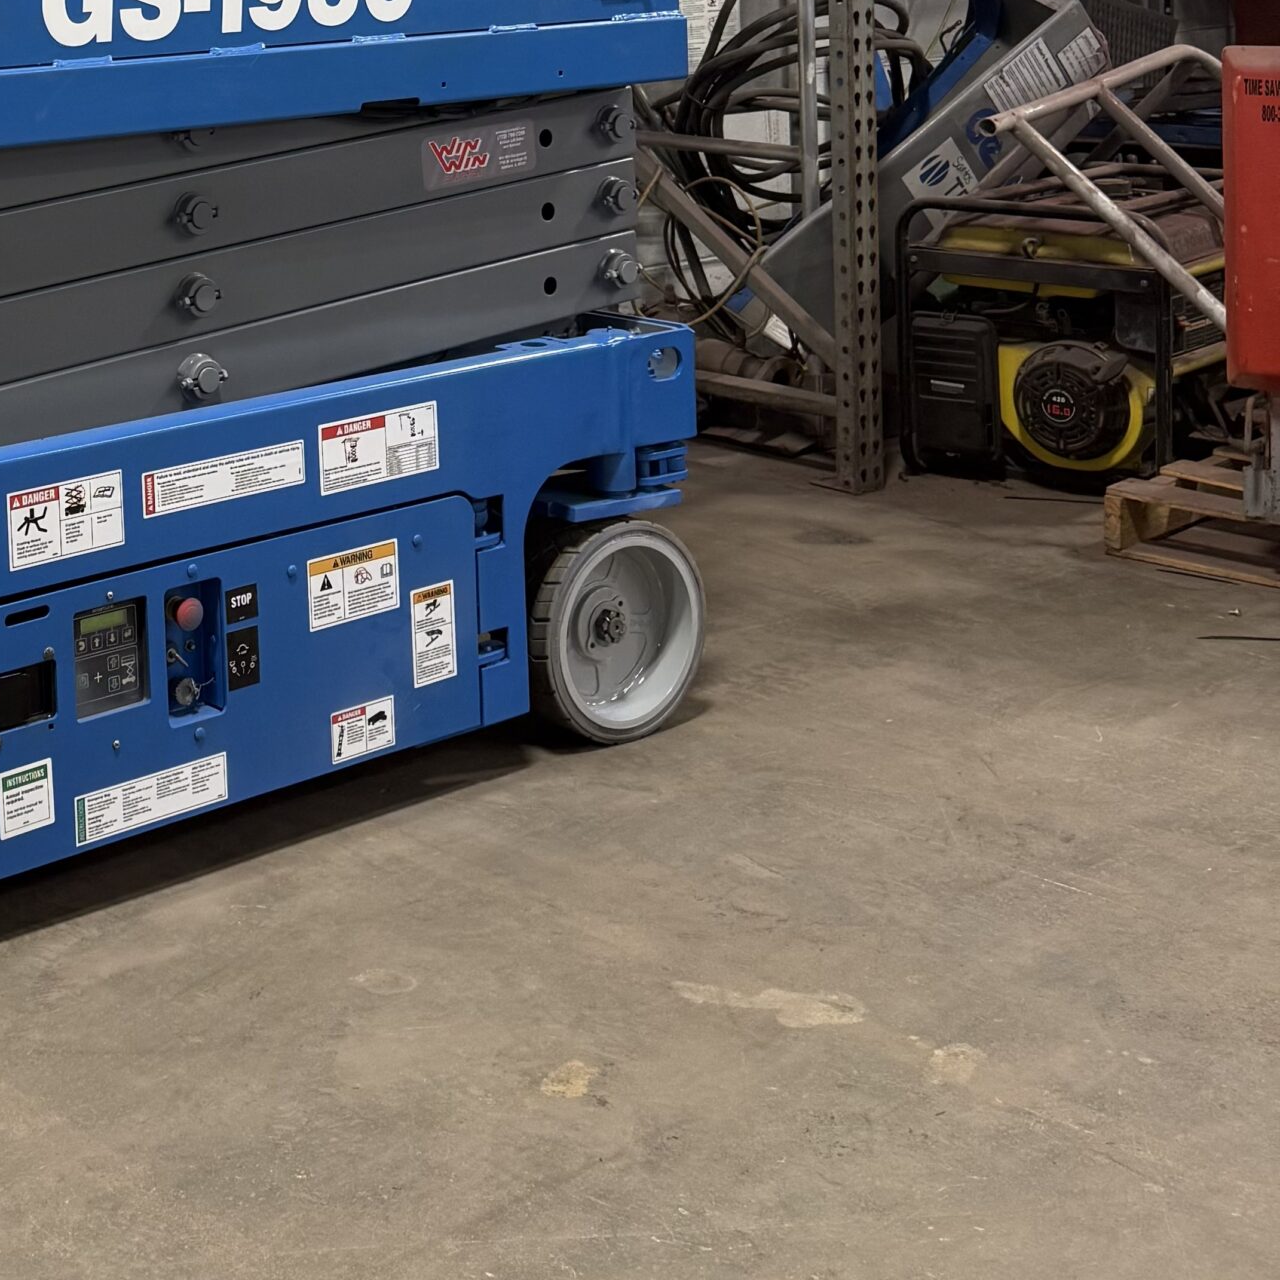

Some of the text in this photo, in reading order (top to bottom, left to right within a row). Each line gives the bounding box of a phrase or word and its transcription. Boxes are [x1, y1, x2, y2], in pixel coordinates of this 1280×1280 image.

[1244, 78, 1263, 96] TIME
[344, 420, 371, 434] DANGER
[21, 488, 56, 504] DANGER
[339, 549, 373, 566] WARNING
[231, 592, 252, 609] STOP
[6, 768, 45, 788] INSTRUCTIONS
